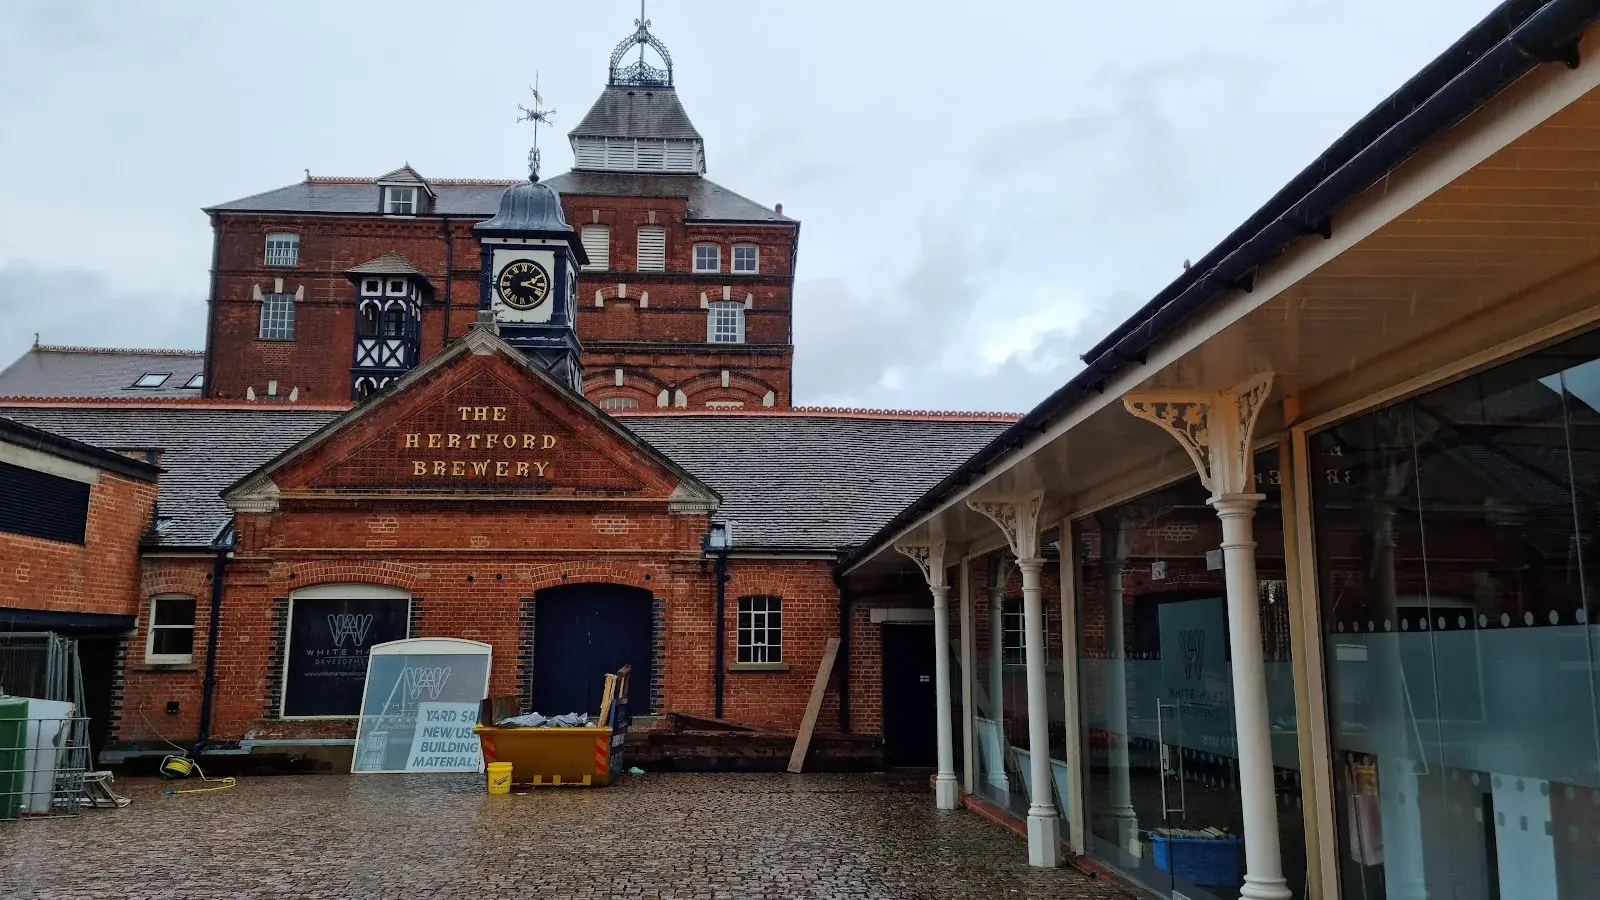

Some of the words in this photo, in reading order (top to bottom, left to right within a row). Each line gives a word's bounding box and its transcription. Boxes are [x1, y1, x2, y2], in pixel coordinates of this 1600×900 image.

[457, 406, 507, 422] THE
[404, 432, 557, 450] HERTFORD
[412, 459, 549, 477] BREWERY
[426, 710, 457, 722] YARD
[460, 710, 476, 723] SA
[420, 741, 479, 753] BUILDING
